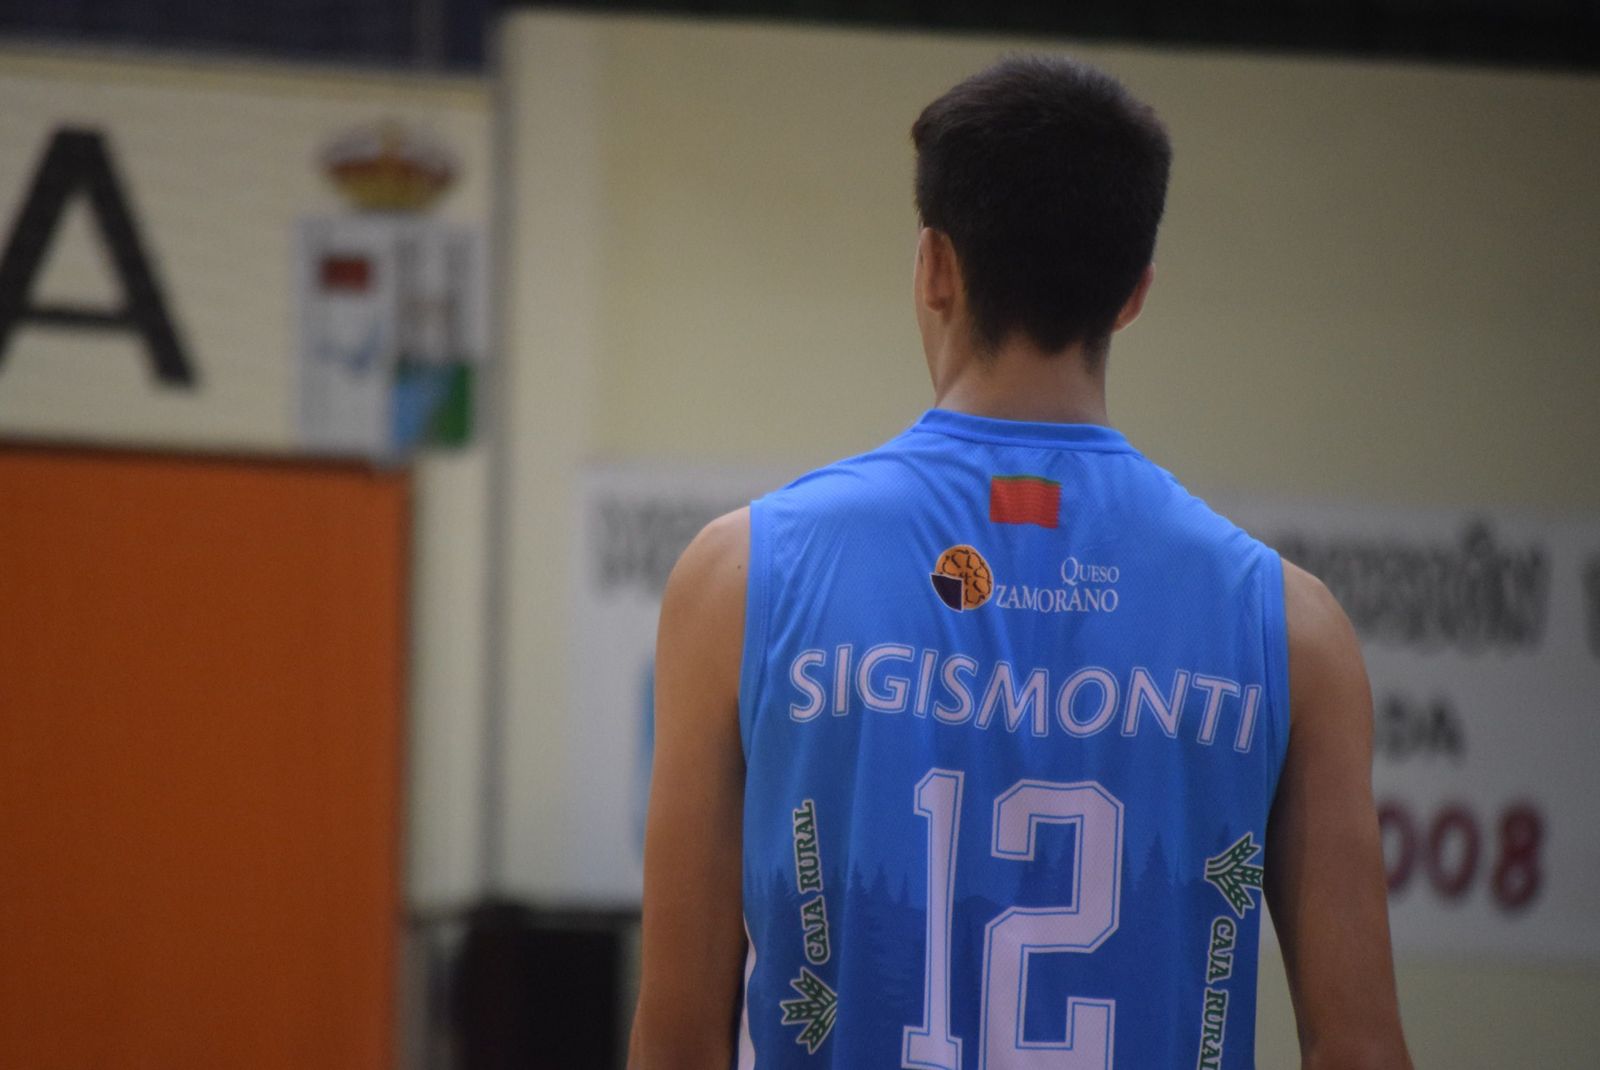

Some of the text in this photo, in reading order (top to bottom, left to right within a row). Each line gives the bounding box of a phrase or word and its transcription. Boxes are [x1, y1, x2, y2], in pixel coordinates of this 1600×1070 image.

[0, 124, 196, 388] A
[995, 584, 1120, 613] ZAMORANO
[789, 643, 1262, 753] SIGISMONTI
[793, 800, 831, 965] CAJA RURAL
[902, 768, 1125, 1070] 12
[1206, 916, 1237, 985] CAJA
